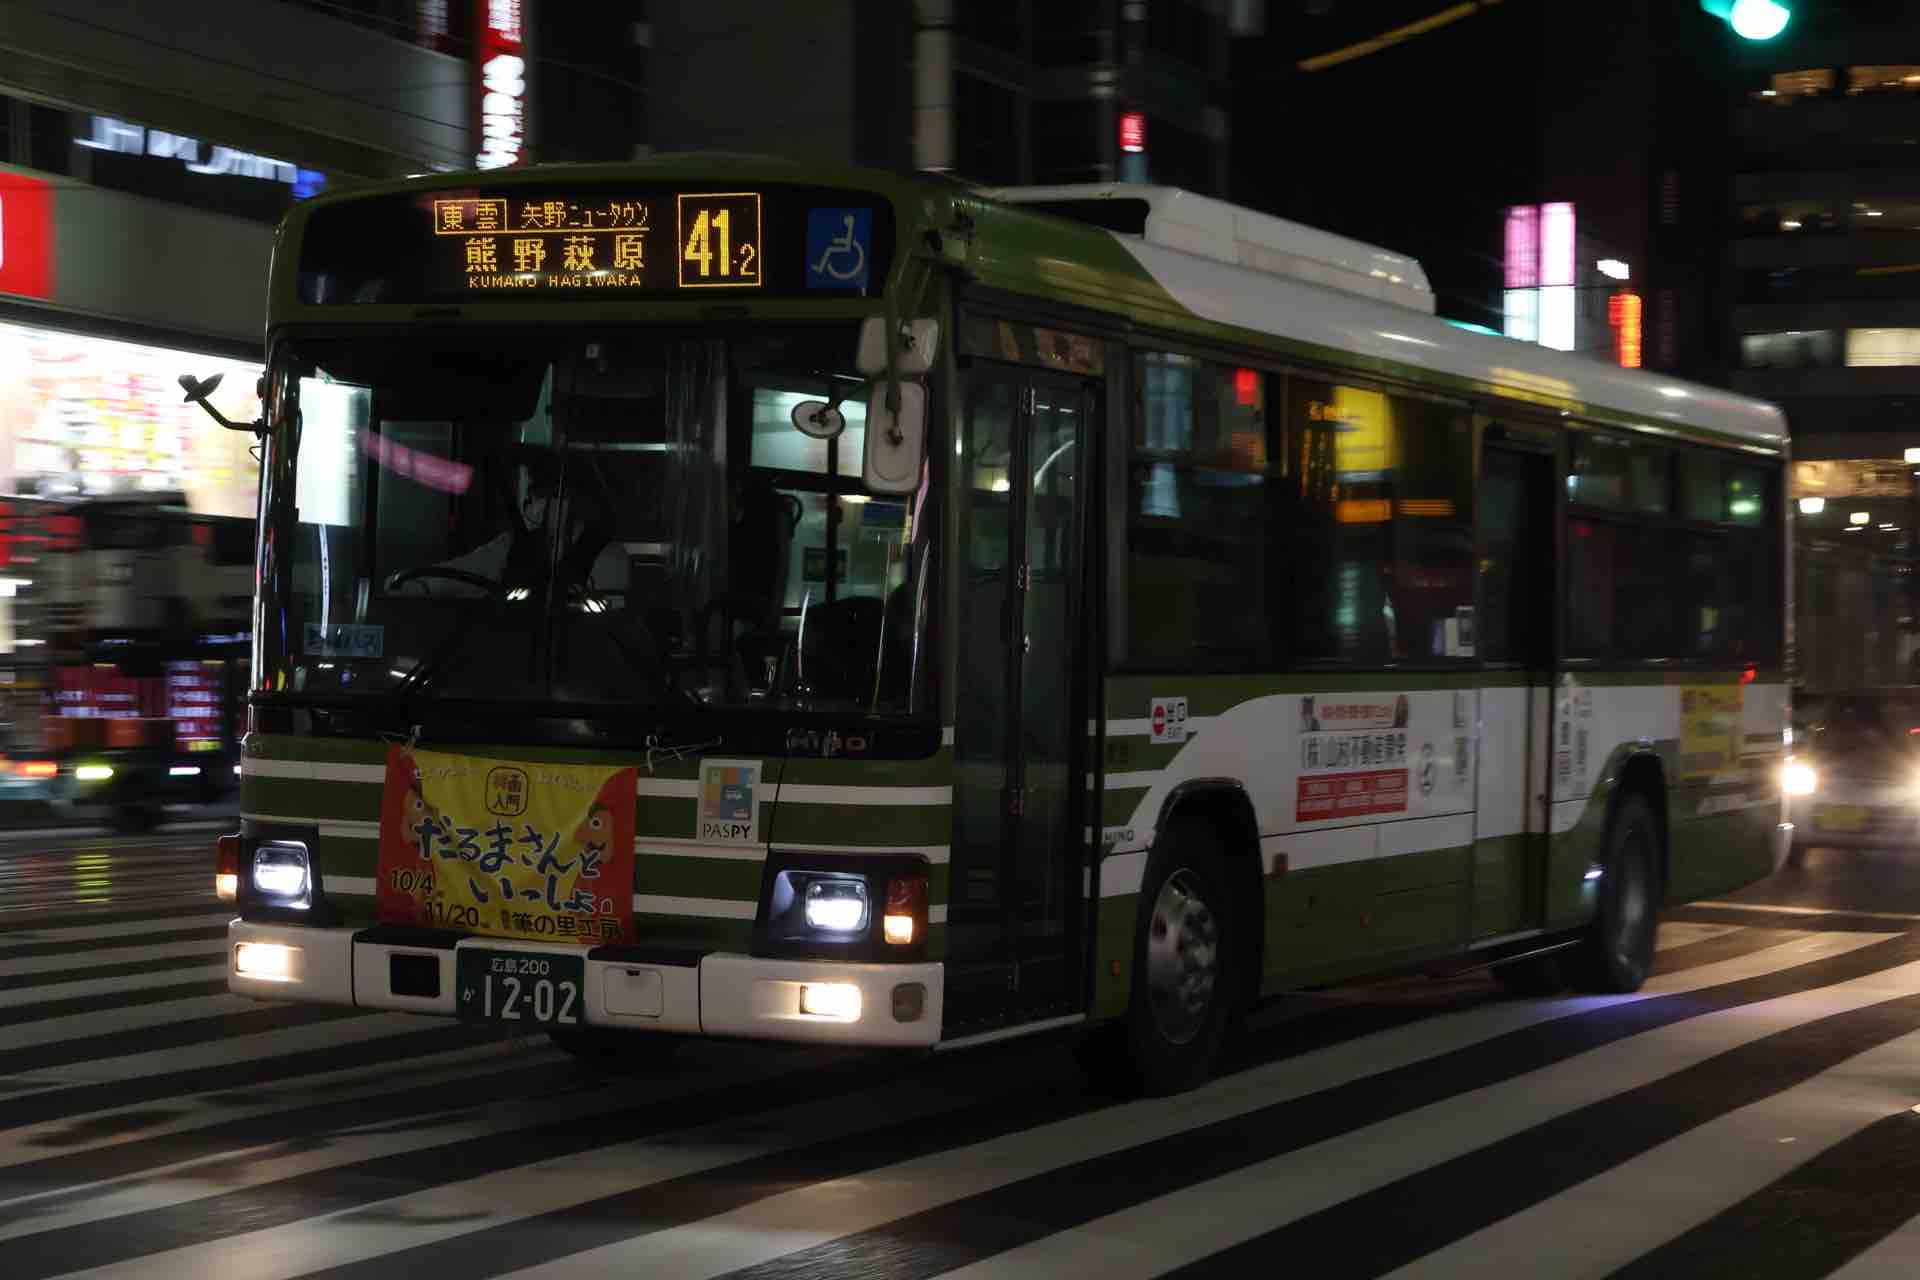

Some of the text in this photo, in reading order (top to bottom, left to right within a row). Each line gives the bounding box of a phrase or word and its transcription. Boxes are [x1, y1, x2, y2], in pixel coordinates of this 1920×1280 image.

[441, 204, 499, 231] 東雲
[465, 236, 645, 273] 熊野萩原
[469, 274, 641, 288] KUMANO HAGIWARA
[415, 815, 601, 878] だるまさんと
[703, 823, 751, 840] PASPY
[484, 974, 577, 1024] 12-02
